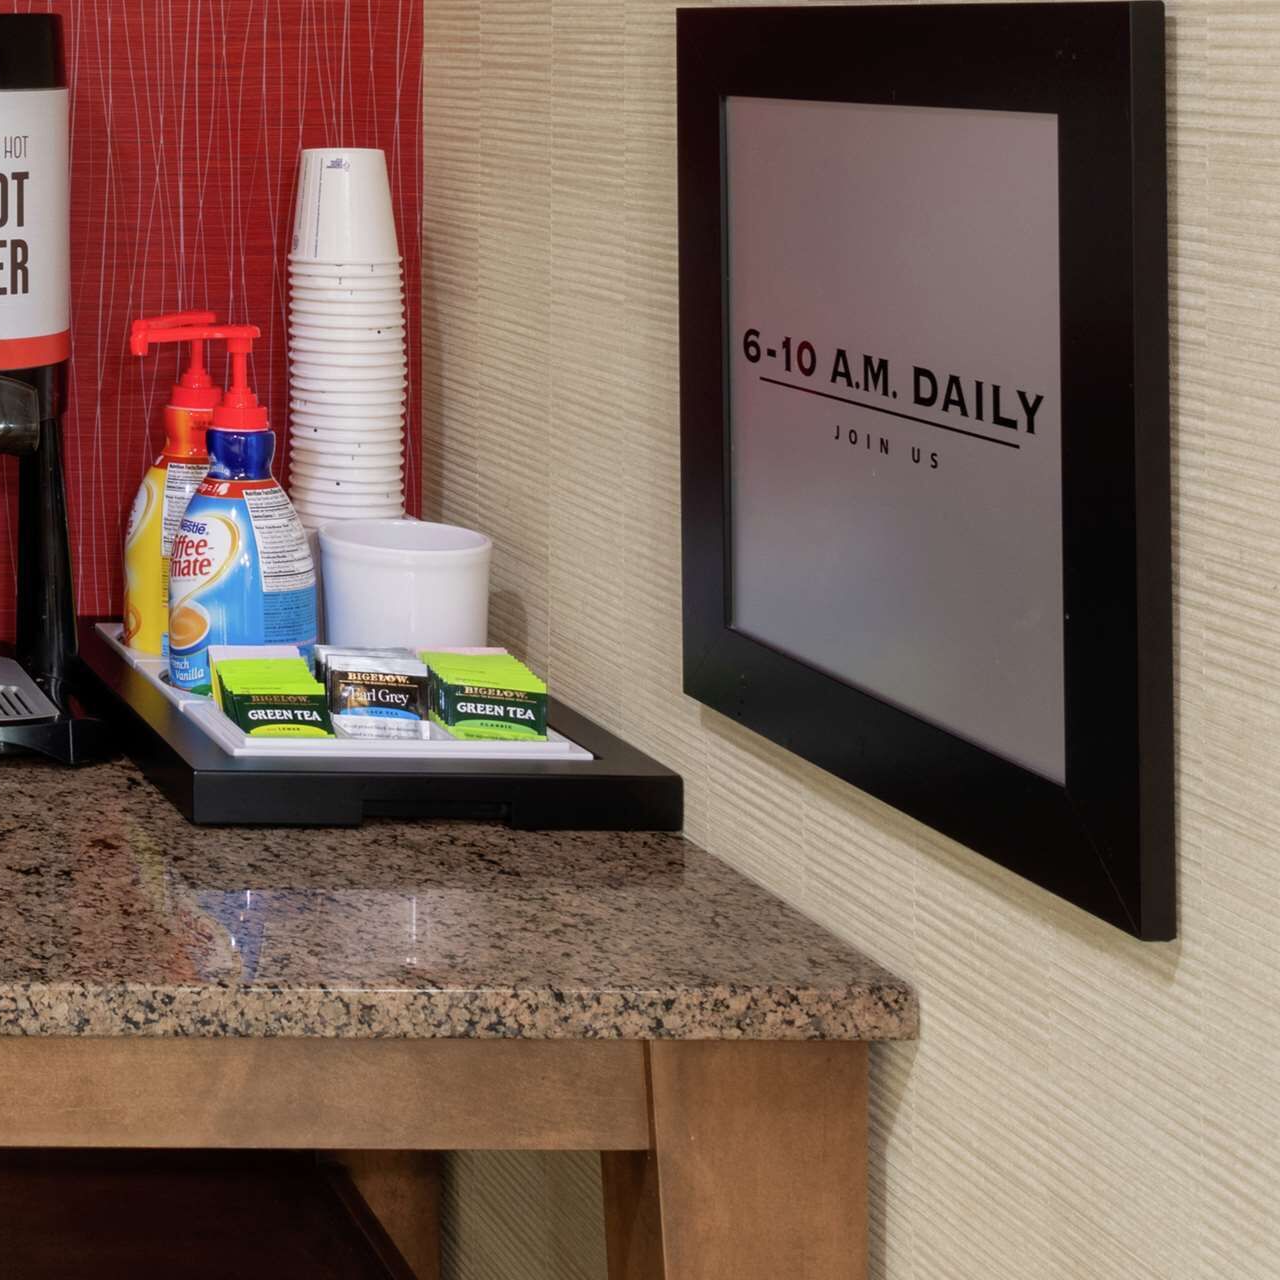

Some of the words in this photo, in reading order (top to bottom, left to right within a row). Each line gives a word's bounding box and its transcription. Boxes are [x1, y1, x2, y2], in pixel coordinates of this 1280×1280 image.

[4, 135, 30, 159] HOT
[743, 328, 817, 377] 6-10
[830, 349, 898, 400] A.M.
[913, 366, 1044, 435] DAILY
[834, 425, 889, 456] JOIN
[912, 446, 940, 469] US
[351, 686, 376, 702] Earl
[378, 688, 409, 706] Grey
[248, 709, 292, 721] GREEN
[293, 710, 322, 722] TEA
[456, 702, 504, 717] GREEN
[506, 707, 536, 721] TEA
